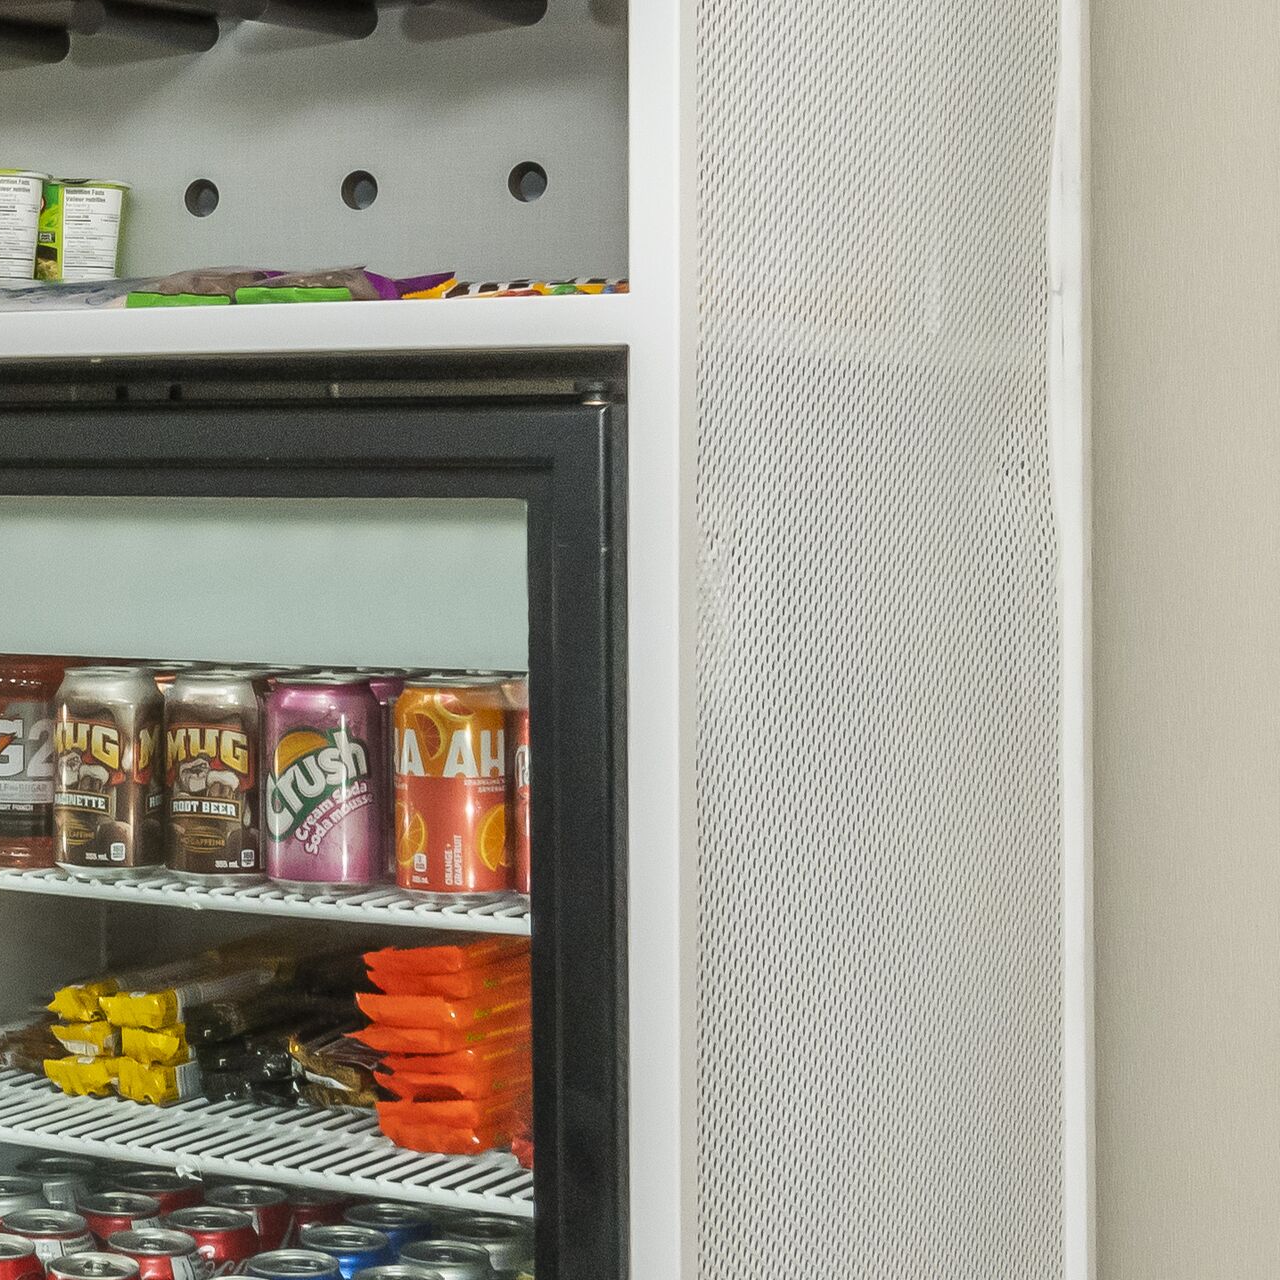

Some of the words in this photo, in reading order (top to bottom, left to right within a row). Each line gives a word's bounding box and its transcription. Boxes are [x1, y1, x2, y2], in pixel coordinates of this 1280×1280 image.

[168, 727, 249, 775] MUG
[173, 800, 200, 813] ROOT
[202, 801, 237, 816] BEER
[295, 799, 335, 842] Cream
[331, 781, 368, 805] Soda
[304, 818, 333, 855] Soda
[444, 847, 454, 887] ORANGE
